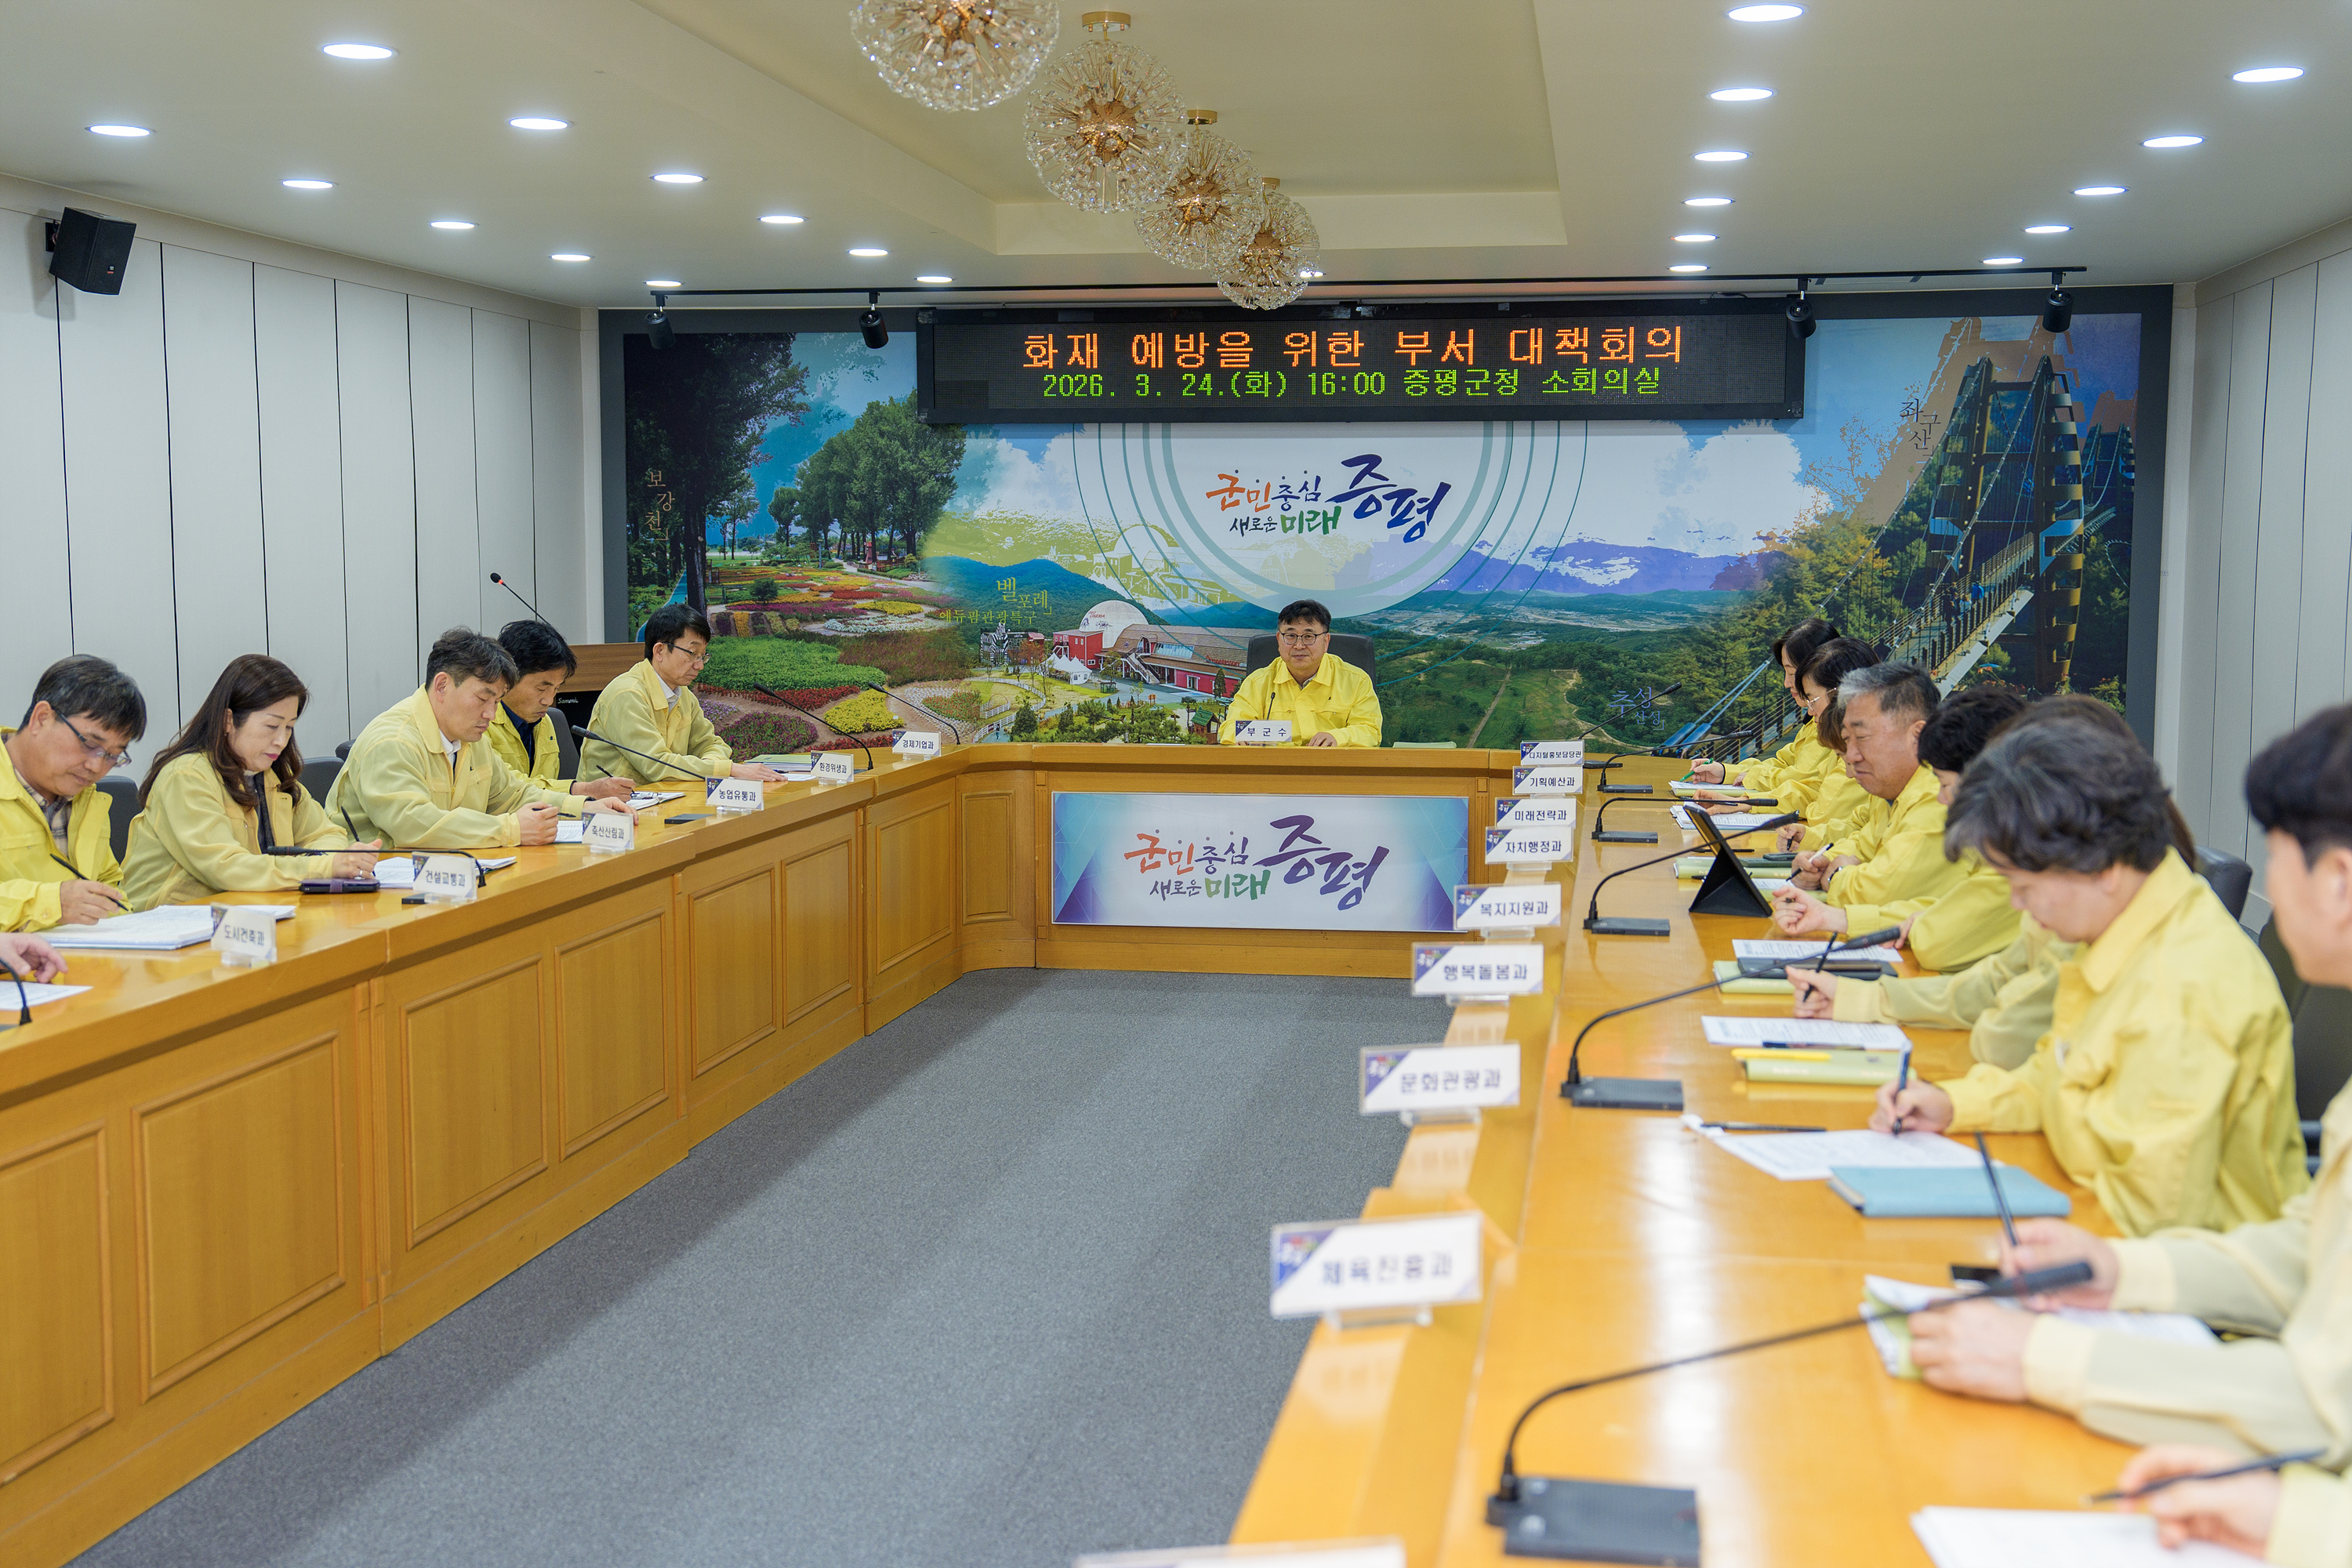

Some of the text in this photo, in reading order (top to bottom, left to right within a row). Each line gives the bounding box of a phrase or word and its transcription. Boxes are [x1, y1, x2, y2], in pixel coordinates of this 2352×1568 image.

[1023, 326, 1681, 368] 화재 예방을 위한 부서 대책회의
[1044, 367, 1660, 397] 2026. 3. 24.(화) 16:00 증평군청 소회의실
[1900, 397, 1941, 450] 좌구산
[645, 470, 676, 531] 보강천
[1206, 473, 1323, 512] 군민중심
[1325, 453, 1452, 543] 증평
[1229, 506, 1342, 537] 새로운 미래
[939, 609, 1037, 625] 에듀팜관광특구
[902, 739, 934, 750] 경제기업과
[1529, 750, 1582, 759] 디지털홍보담당관
[819, 762, 848, 774] 환경위생과
[1530, 777, 1575, 787] 기획예산과
[719, 789, 757, 802] 농업유통과
[1515, 810, 1567, 821] 미래전략과
[592, 825, 624, 840] 축산산림과
[1123, 833, 1249, 876] 군민중심
[1505, 840, 1562, 853] 자치행정과
[1253, 814, 1391, 911] 증평
[426, 869, 466, 887] 건설교통과
[1149, 869, 1271, 901] 새로운 미래
[1480, 901, 1548, 916] 복지지원과
[224, 924, 265, 946] 도시건축과
[1443, 964, 1527, 982] 행복돌봄과
